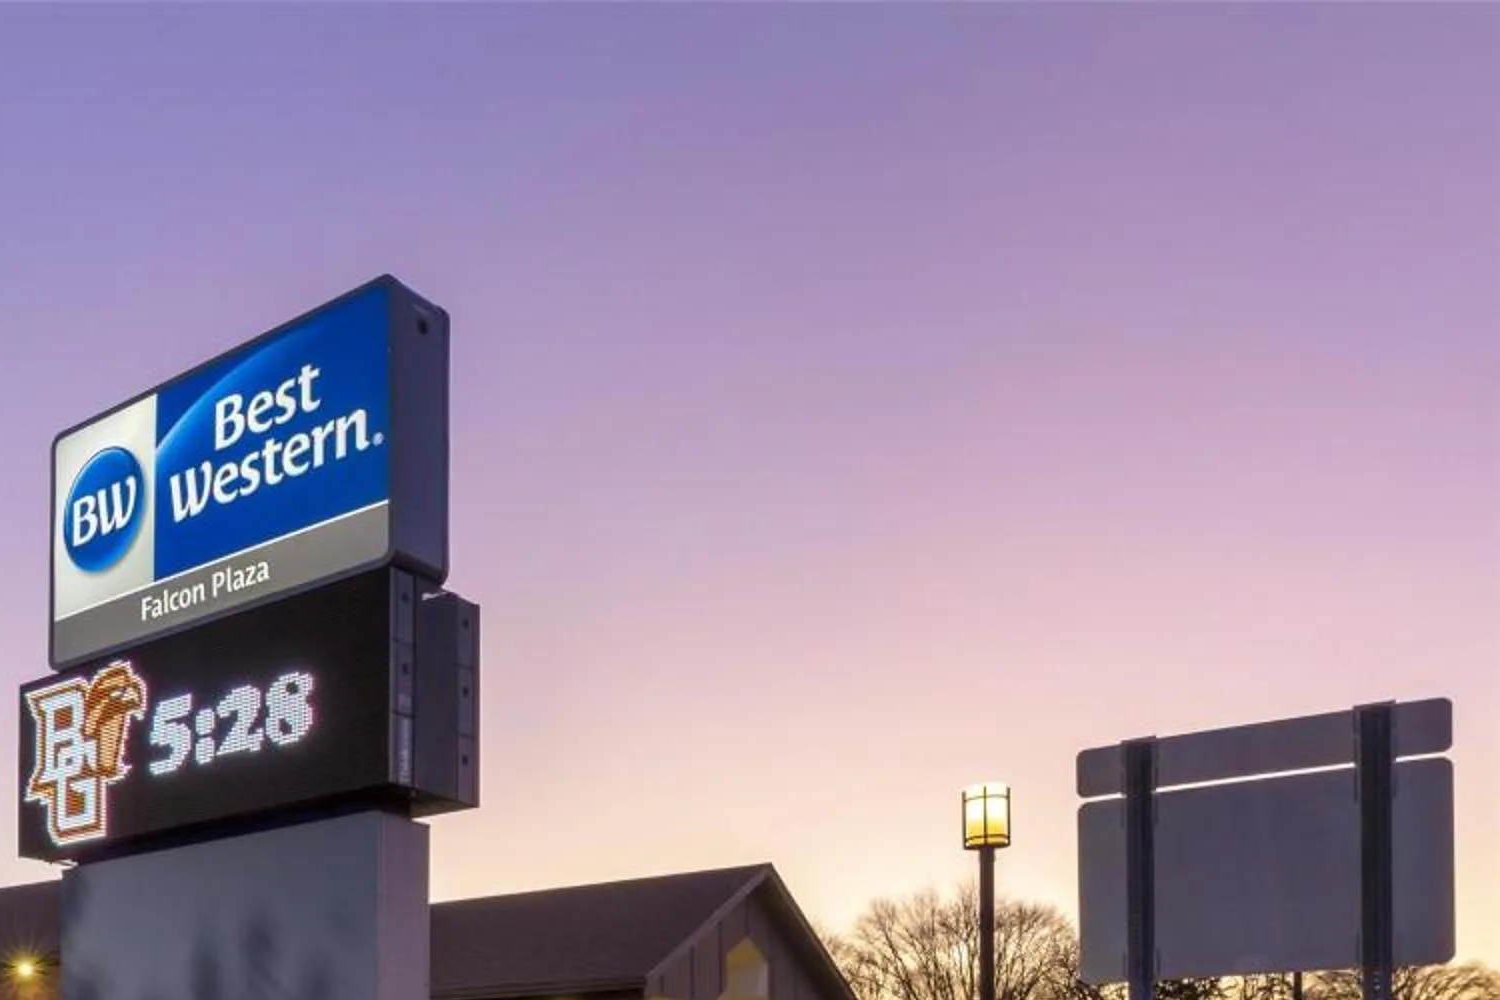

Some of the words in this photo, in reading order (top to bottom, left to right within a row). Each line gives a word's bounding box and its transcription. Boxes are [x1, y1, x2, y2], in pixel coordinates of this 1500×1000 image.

[215, 363, 321, 450] Best
[72, 475, 137, 547] BW
[140, 581, 206, 621] Falcon
[212, 560, 271, 598] Plaza
[150, 671, 314, 775] 5:28
